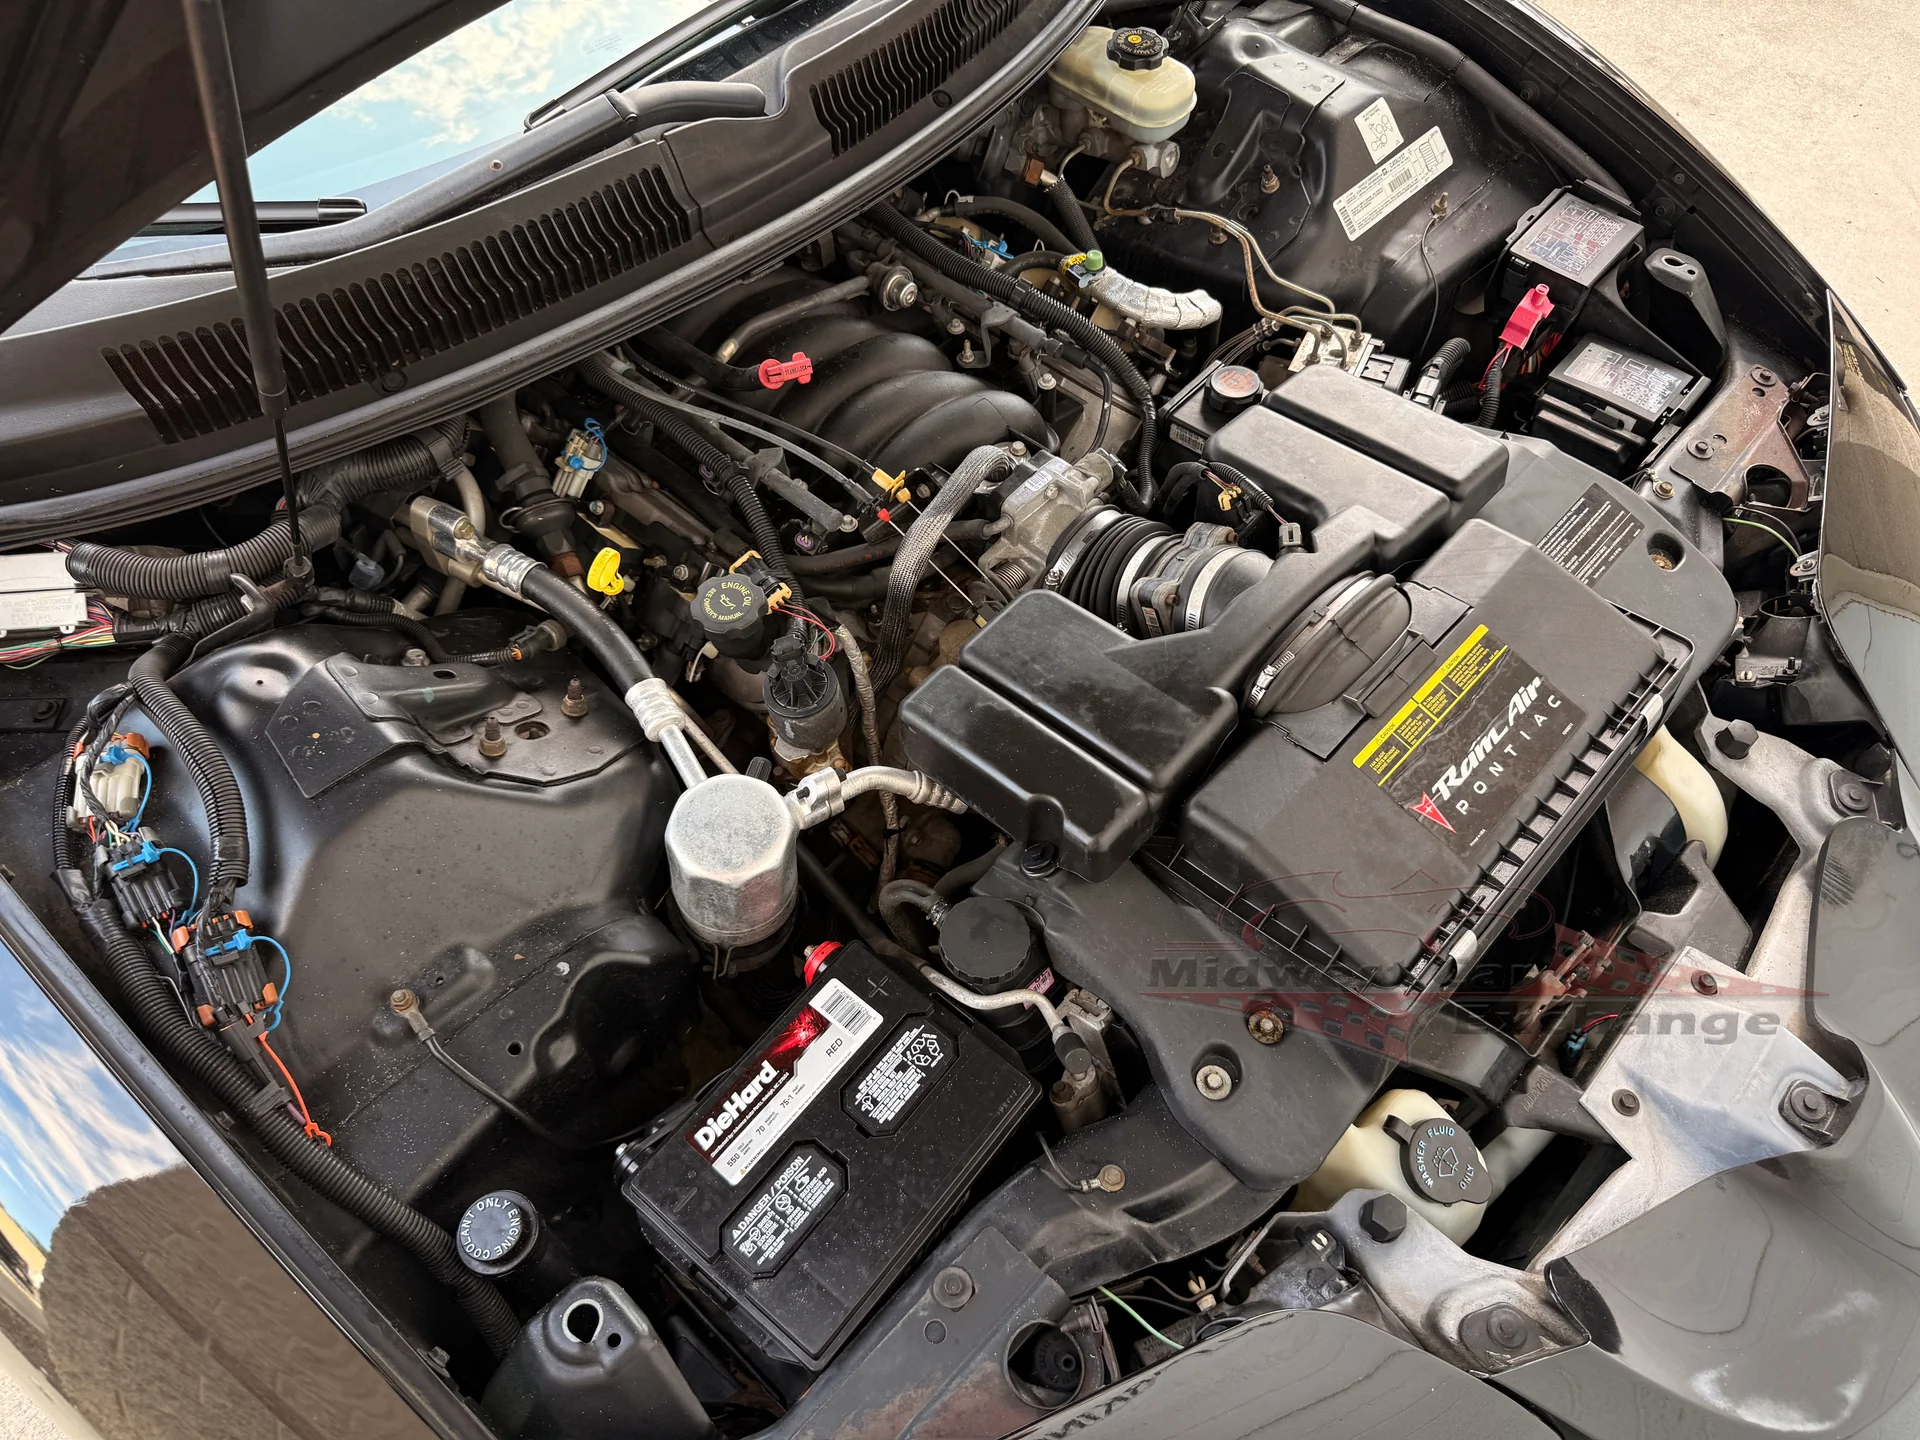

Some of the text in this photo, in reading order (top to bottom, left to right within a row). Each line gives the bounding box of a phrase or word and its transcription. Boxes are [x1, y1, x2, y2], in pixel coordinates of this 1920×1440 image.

[705, 587, 717, 598] SEE
[717, 611, 744, 621] MANUAL
[721, 581, 752, 607] ENGINE OIL
[1446, 655, 1460, 669] CAUTION
[1380, 723, 1396, 739] CAUTION
[1455, 694, 1562, 815] PONTIAC
[826, 1038, 843, 1057] RED
[694, 1060, 777, 1150] DieHard
[710, 1137, 729, 1158] Distributed
[733, 1118, 747, 1134] Advance
[745, 1109, 755, 1120] Auto
[727, 1094, 793, 1167] 550 70 75-1
[1415, 1125, 1475, 1190] WASHER FLUID ONLY
[739, 1193, 774, 1233] DANGER
[773, 1155, 805, 1190] POISON
[785, 1205, 794, 1215] NO
[460, 1197, 521, 1260] ENGINE COOLANT ONLY
